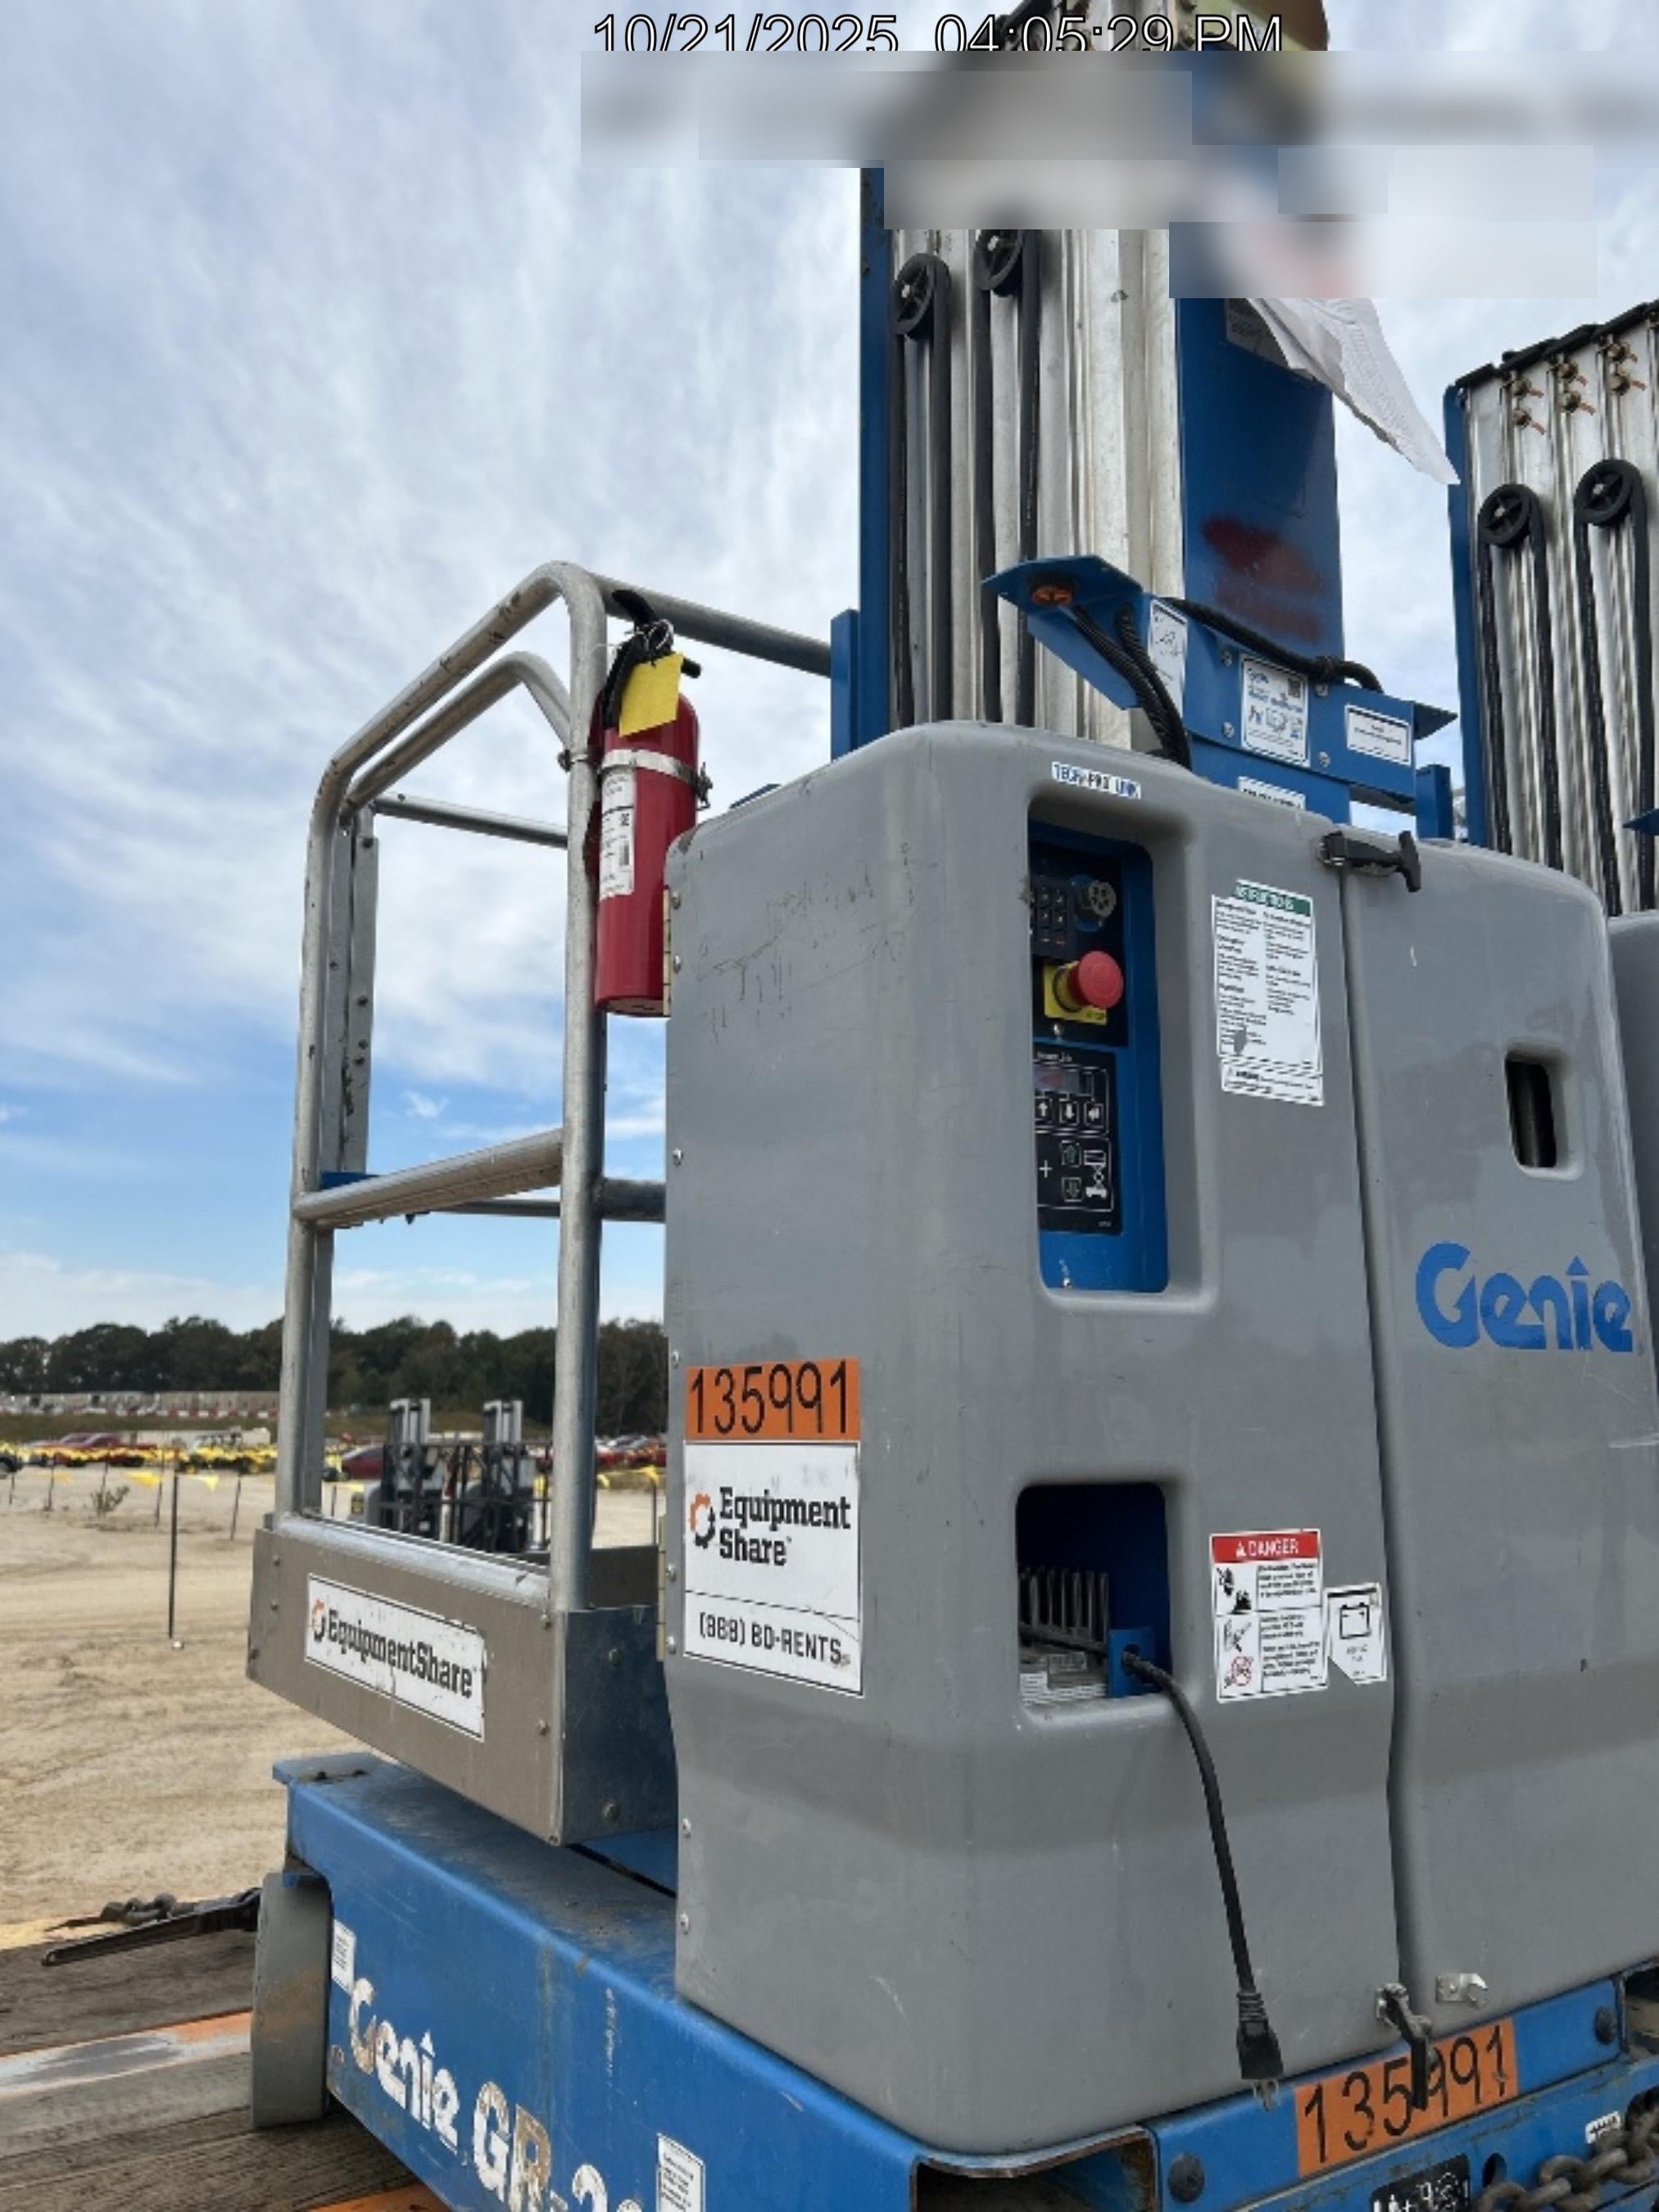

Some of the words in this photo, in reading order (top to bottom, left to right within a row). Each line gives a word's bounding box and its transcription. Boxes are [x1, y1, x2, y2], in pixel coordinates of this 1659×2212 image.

[1415, 1240, 1633, 1353] Genie
[691, 1361, 846, 1435] 135991
[719, 1487, 851, 1531] Equipment
[719, 1528, 787, 1566] Share
[1248, 1538, 1299, 1557] DANGER
[328, 1608, 473, 1699] EquipmentShare
[349, 1977, 459, 2156] Genie
[473, 2080, 643, 2212] GR-
[1303, 2024, 1507, 2164] 135991
